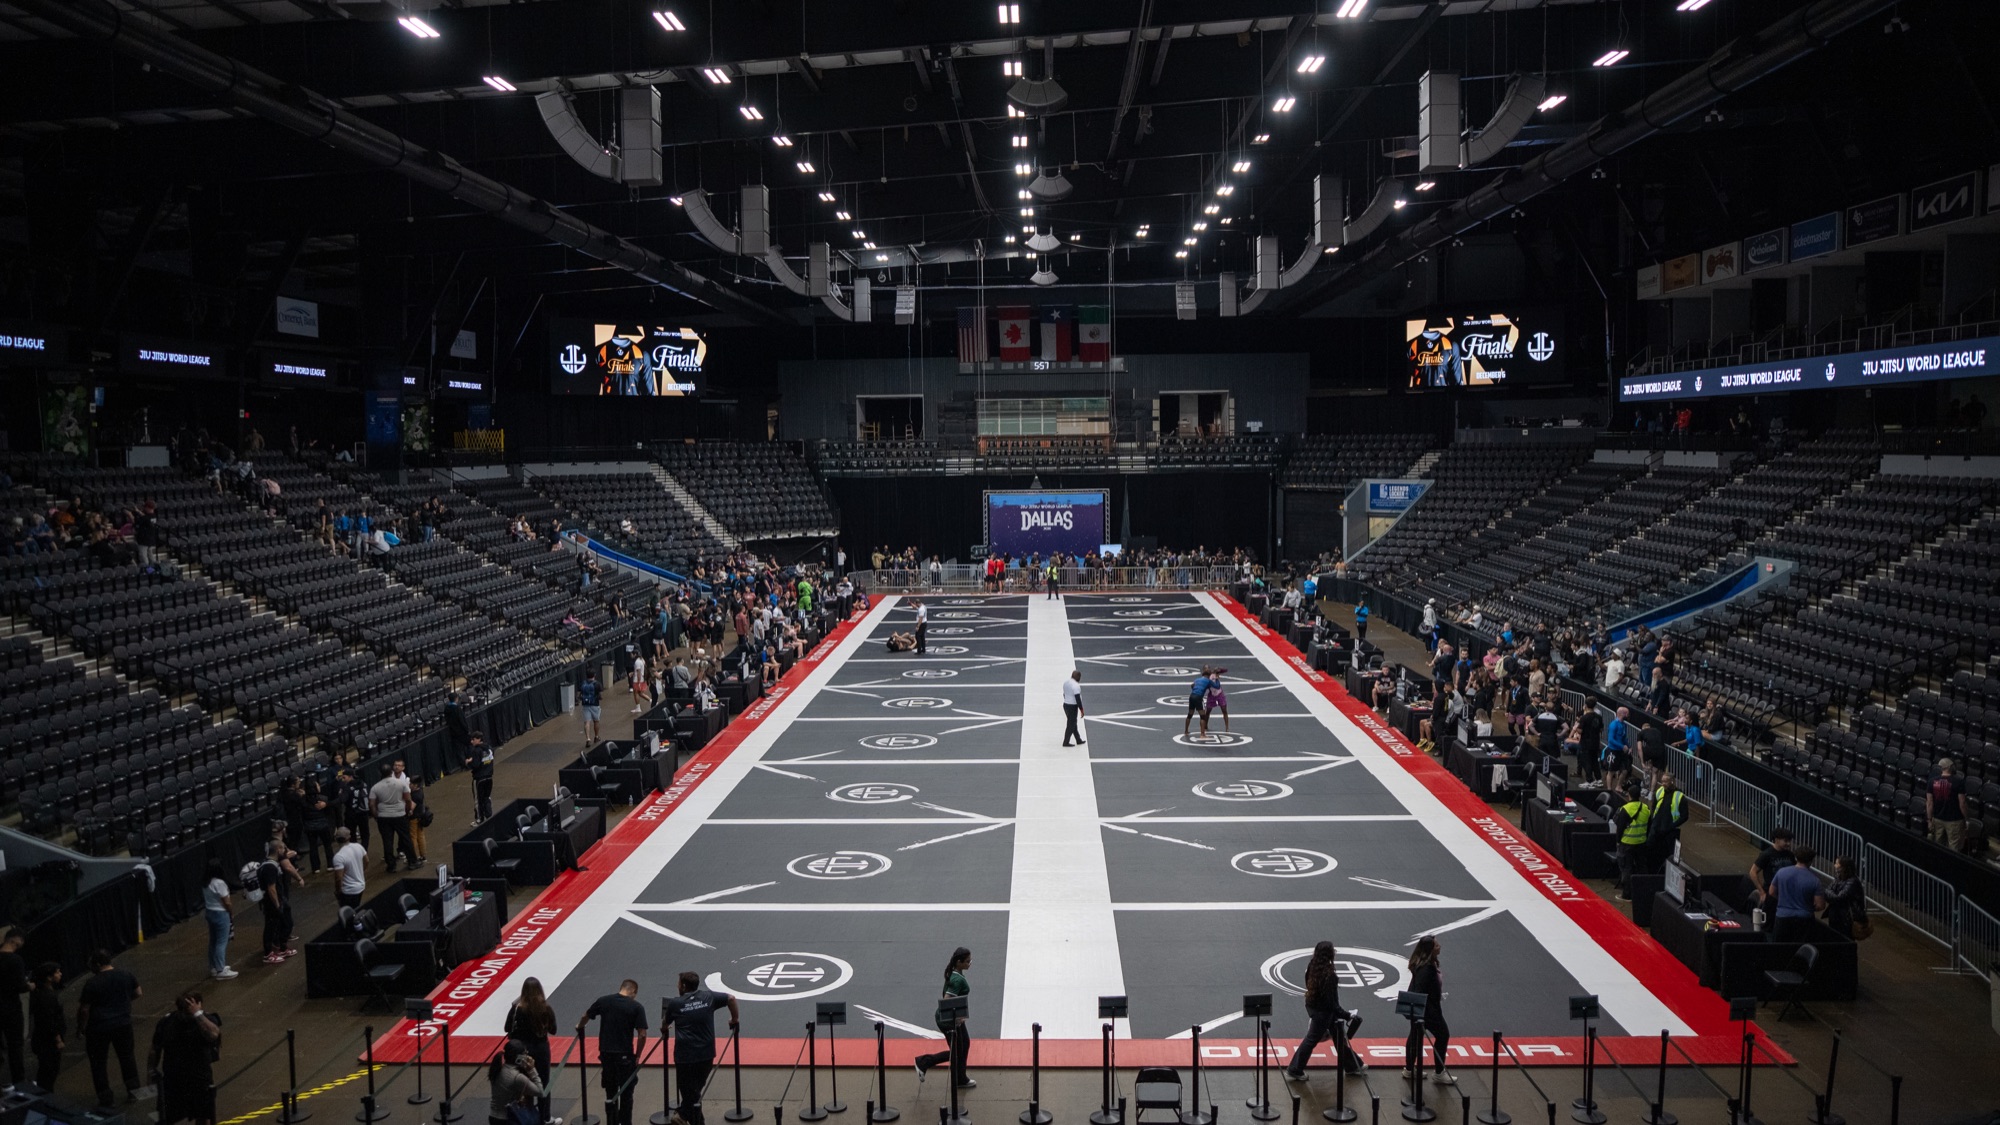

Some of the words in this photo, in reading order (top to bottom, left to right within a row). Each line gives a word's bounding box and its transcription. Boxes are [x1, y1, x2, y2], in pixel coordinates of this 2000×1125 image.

[1918, 186, 1968, 219] KIA
[1794, 231, 1831, 248] ticketmaster
[14, 336, 45, 350] LEAGUE
[1461, 333, 1512, 360] Finals
[139, 350, 151, 360] JIU
[152, 350, 168, 361] JITSU
[168, 352, 188, 363] WORLD
[189, 354, 210, 365] LEAGUE
[607, 358, 635, 373] Finals
[652, 344, 700, 371] Finals
[1418, 352, 1444, 366] Finals
[1862, 360, 1878, 375] JIU
[1880, 358, 1904, 375] JITSU
[1906, 354, 1940, 372] WORLD
[1943, 350, 1986, 369] LEAGUE
[274, 364, 282, 372] JIU
[283, 365, 294, 373] JITSU
[295, 366, 309, 375] WORLD
[310, 368, 326, 377] LEAGUE
[1721, 376, 1732, 387] JIU
[1732, 374, 1749, 386] JITSU
[1750, 371, 1773, 385] WORLD
[1774, 368, 1801, 383] LEAGUE
[404, 377, 416, 385] EAGUE
[1624, 385, 1632, 395] JIU
[1632, 384, 1644, 394] JITSU
[1645, 382, 1661, 393] WORLD
[1662, 380, 1681, 392] LEAGUE
[1021, 511, 1073, 531] DALLAS
[1471, 817, 1519, 844] LEAGUE
[1505, 845, 1549, 871] WORLD
[1533, 872, 1578, 895] JITSU
[527, 907, 562, 925] JIU
[496, 926, 543, 955] JITSU
[448, 958, 513, 1000] WORLD
[407, 1003, 465, 1036] LEAG
